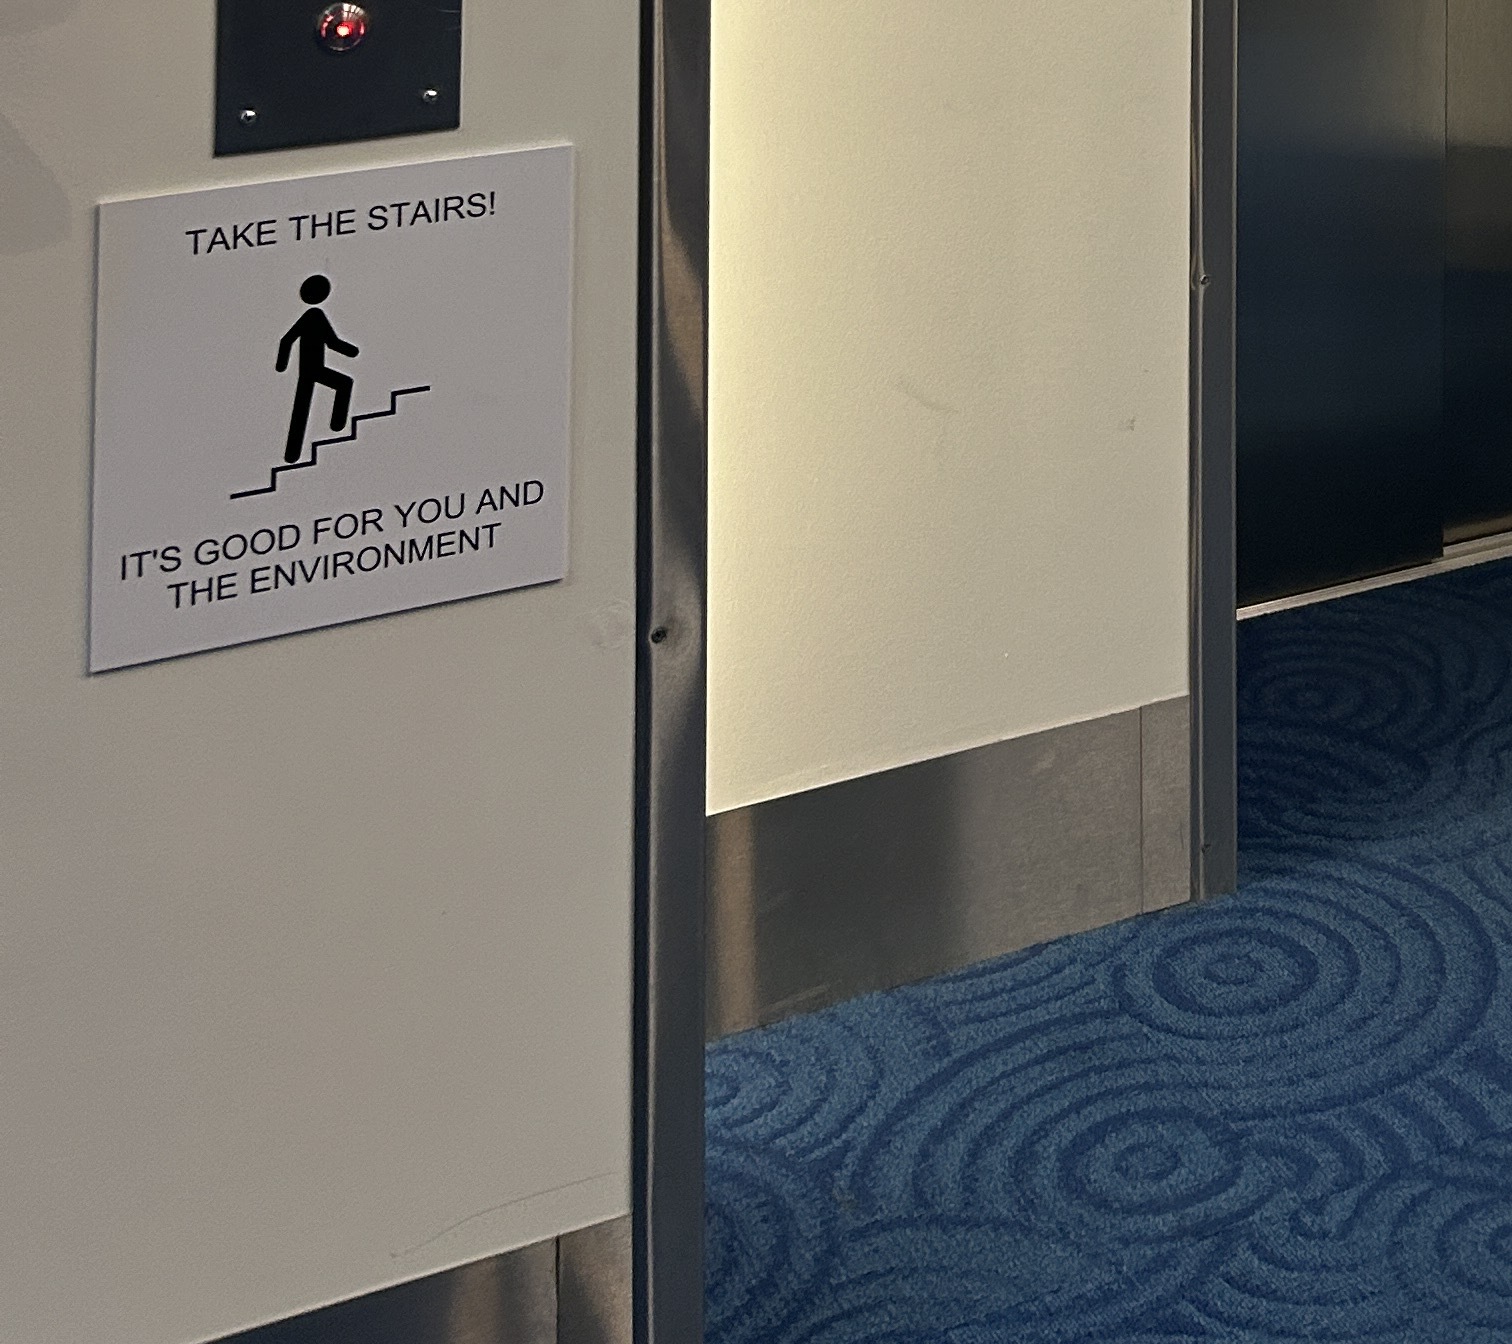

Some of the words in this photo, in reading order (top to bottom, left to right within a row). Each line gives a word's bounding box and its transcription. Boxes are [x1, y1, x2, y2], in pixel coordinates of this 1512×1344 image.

[185, 219, 278, 255] TAKE
[288, 210, 357, 241] THE
[367, 191, 497, 231] STAIRS!
[119, 545, 182, 581] IT'S
[194, 523, 301, 566] GOOD
[312, 507, 385, 546] FOR
[393, 492, 468, 528] YOU
[475, 479, 545, 515] AND
[167, 572, 238, 610] THE
[249, 522, 503, 595] ENVIRONMENT
